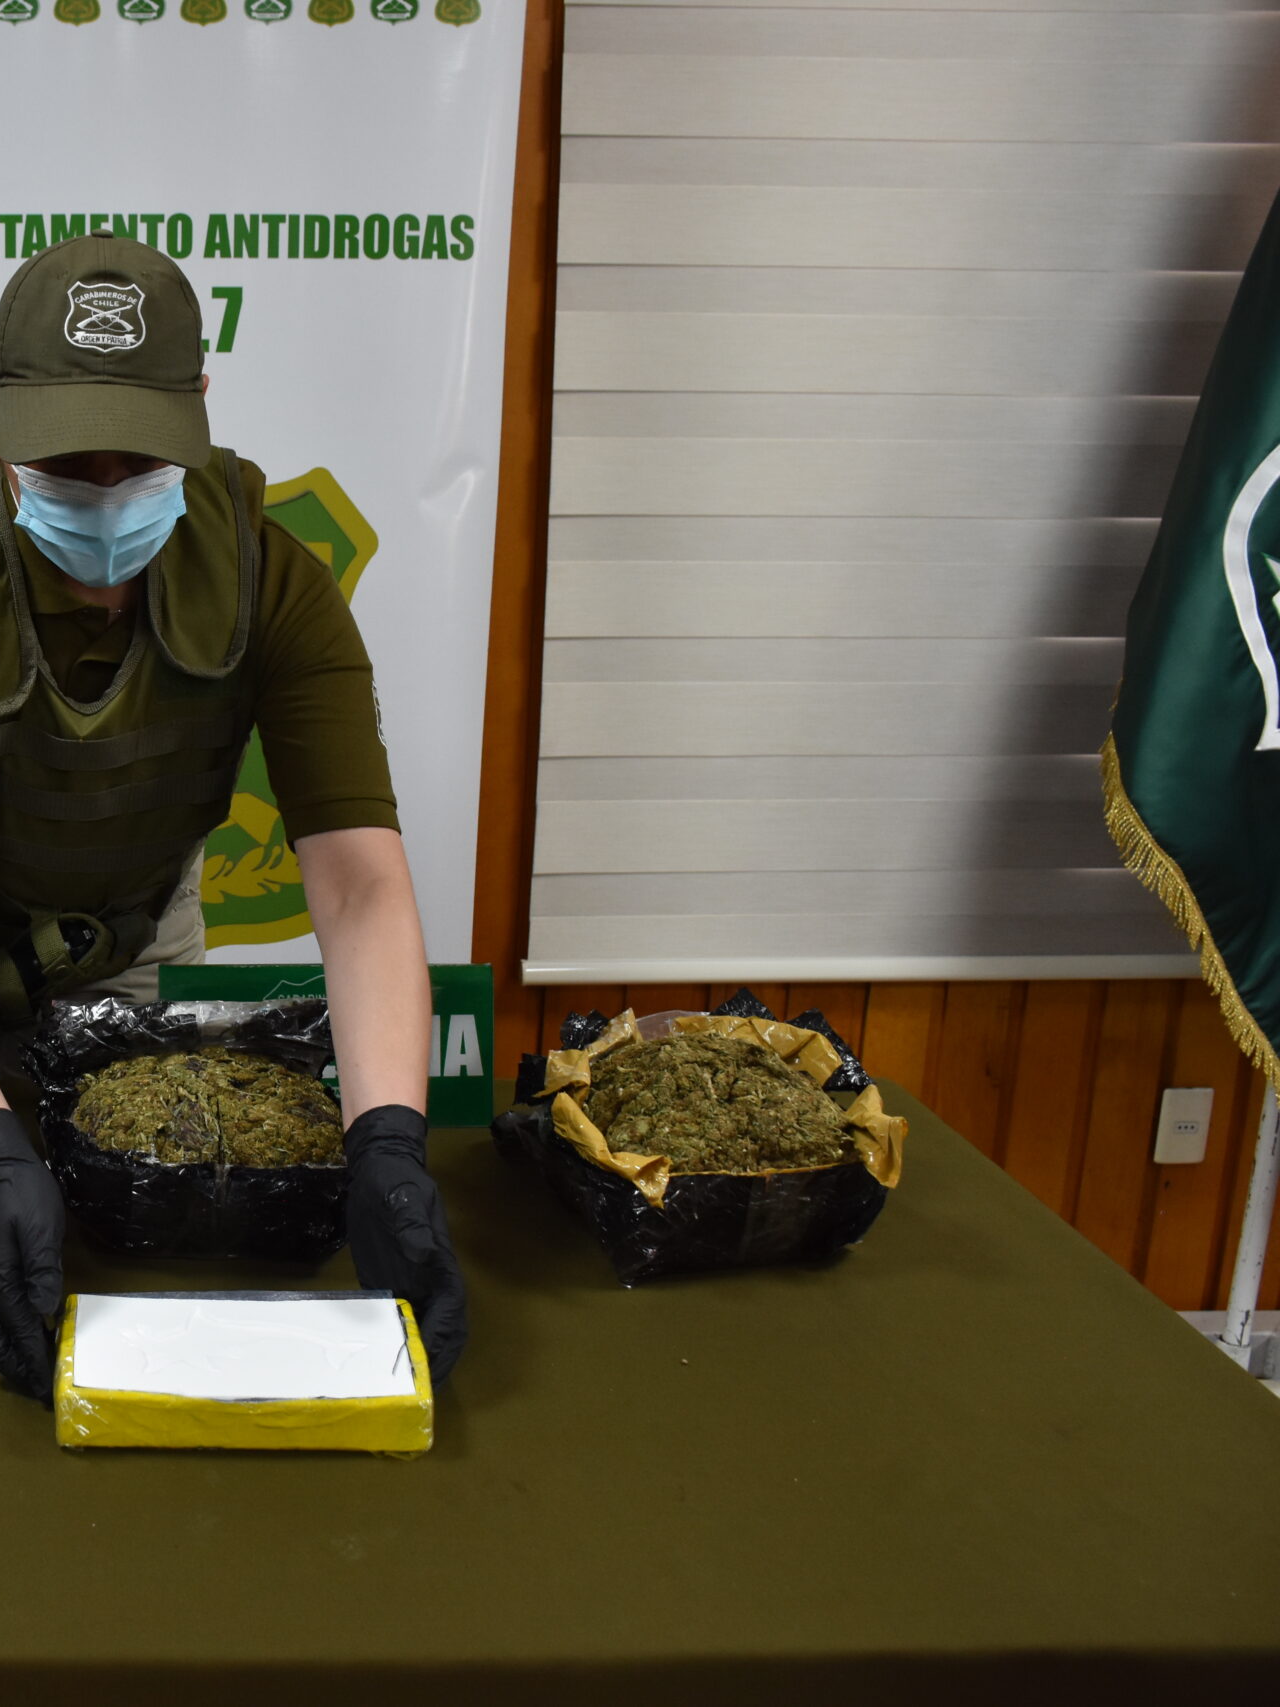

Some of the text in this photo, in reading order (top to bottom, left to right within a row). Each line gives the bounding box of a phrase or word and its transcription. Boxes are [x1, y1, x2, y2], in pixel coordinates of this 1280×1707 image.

[203, 213, 475, 260] ANTIDROGAS
[75, 291, 138, 305] CARABINEROS DE
